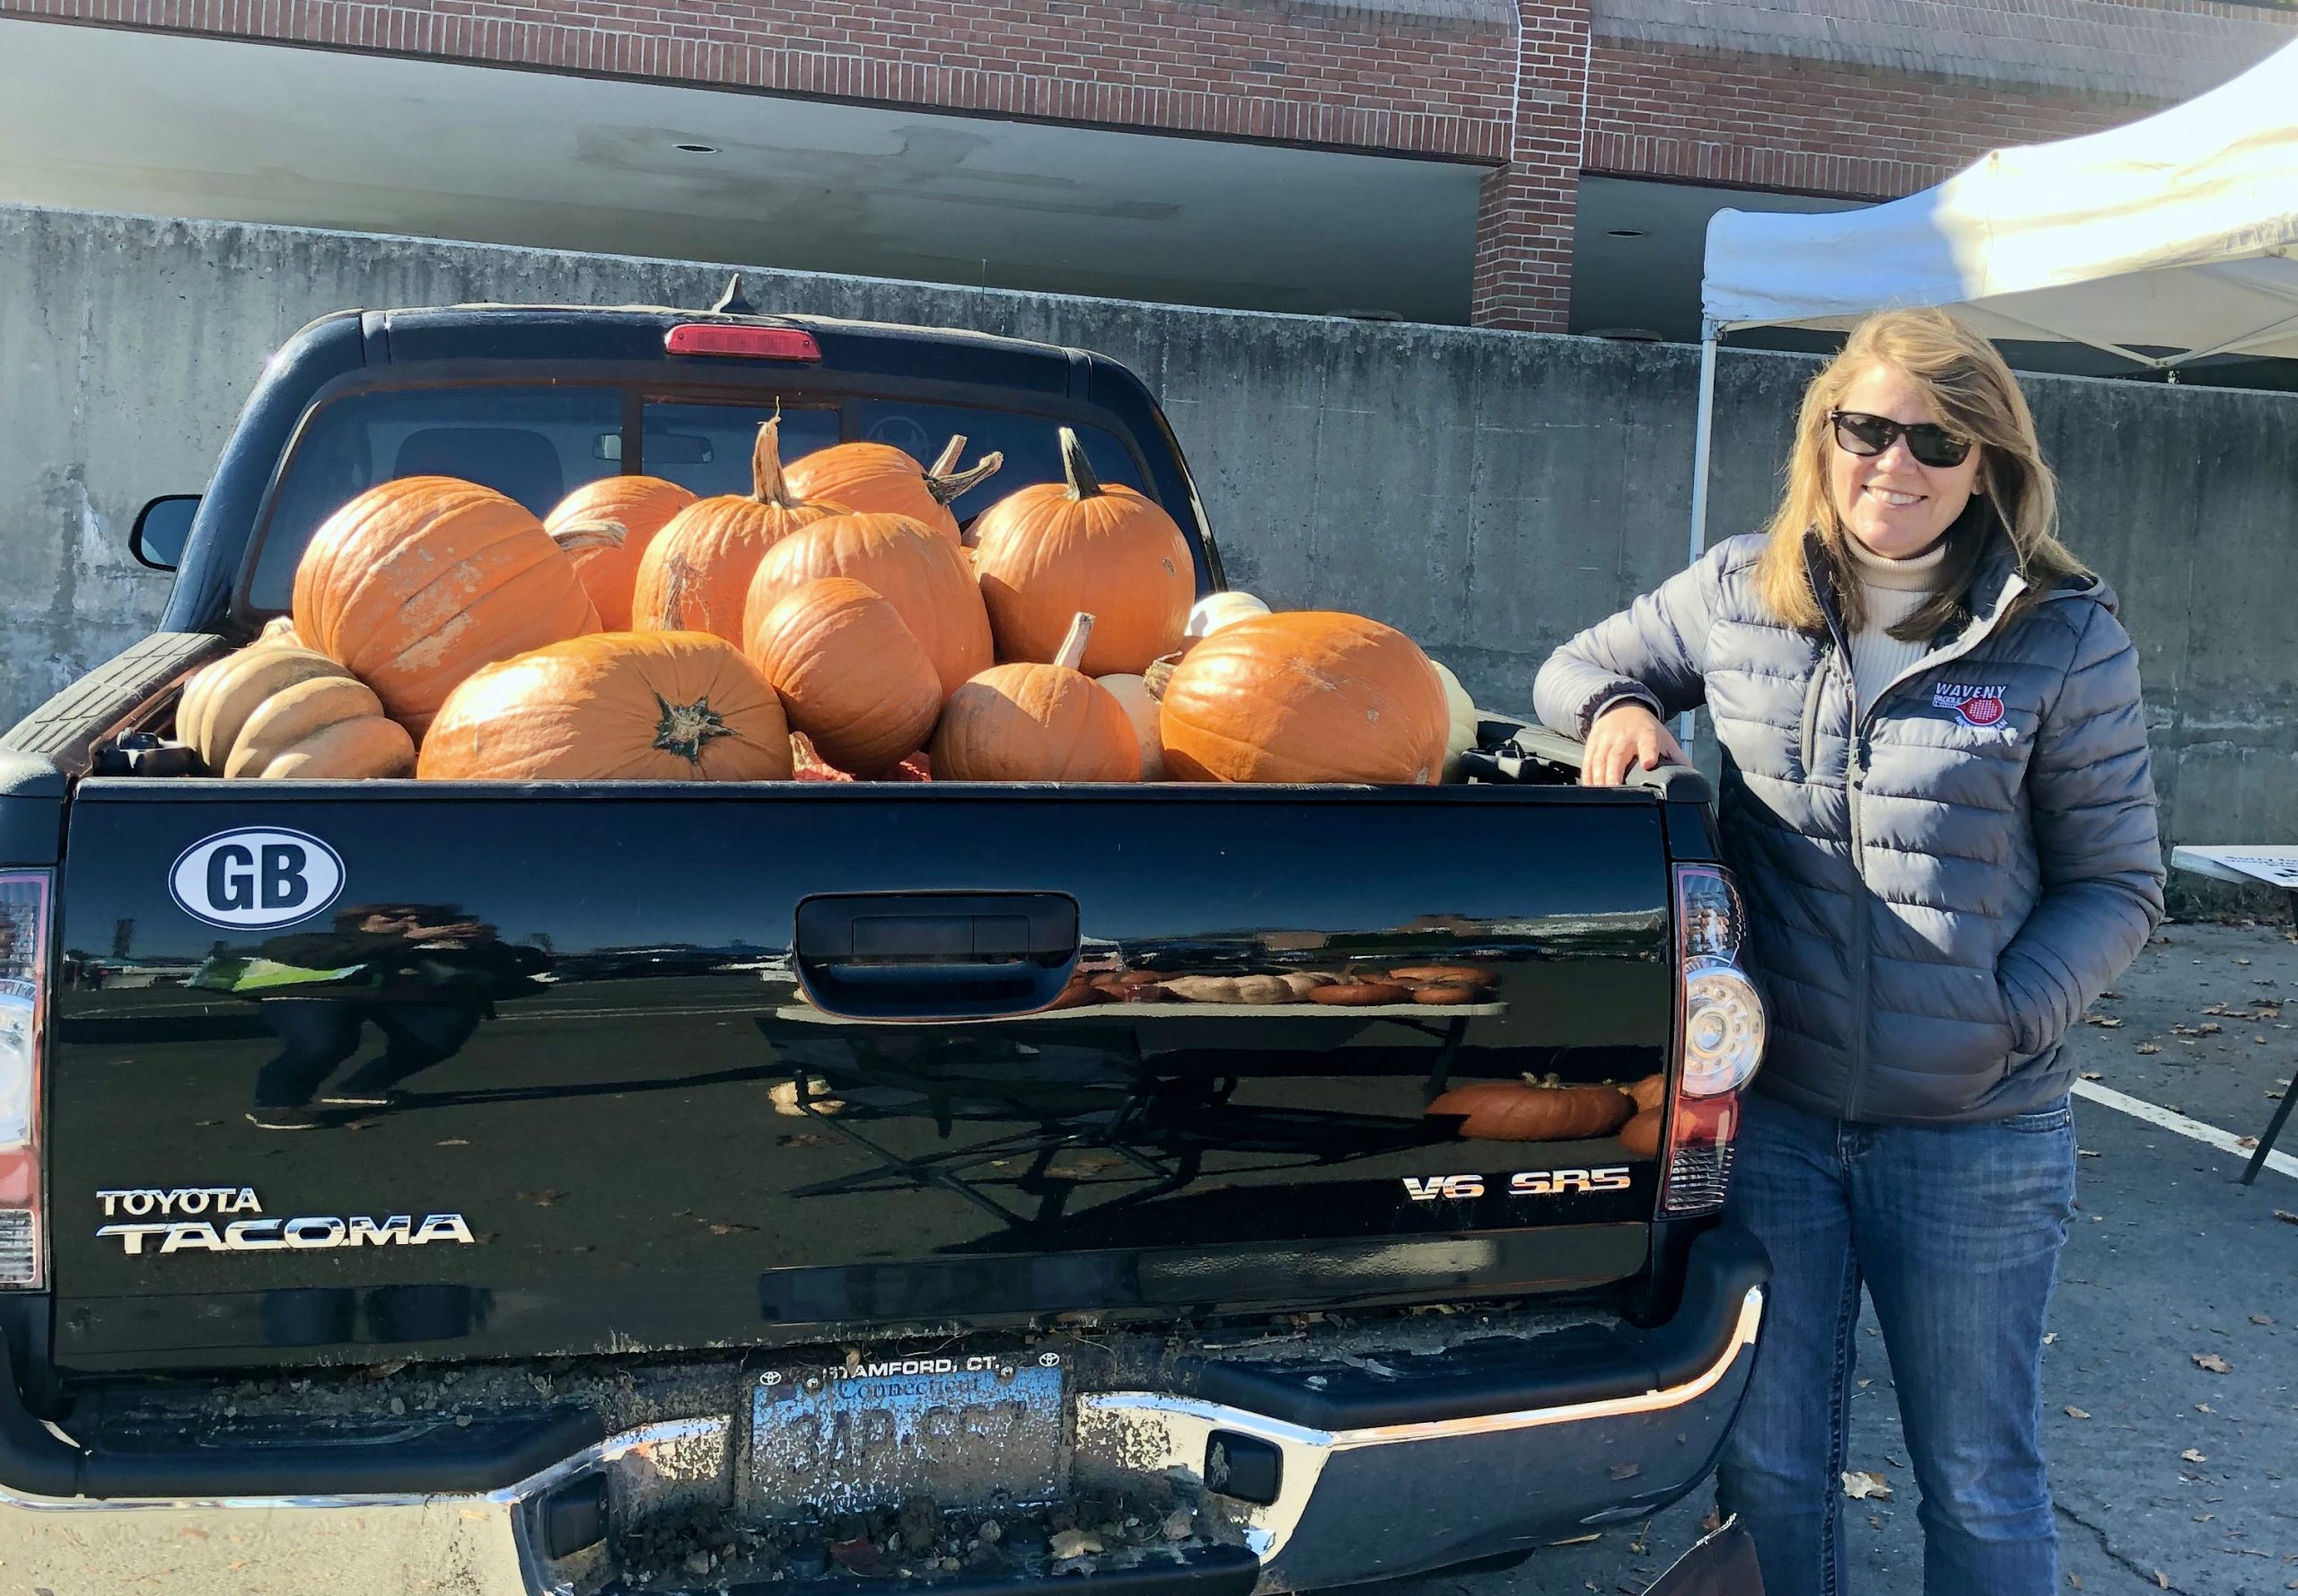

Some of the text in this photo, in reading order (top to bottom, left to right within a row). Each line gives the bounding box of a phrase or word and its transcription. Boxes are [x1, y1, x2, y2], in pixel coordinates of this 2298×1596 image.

[1934, 695, 1962, 705] PADDLE
[1935, 682, 2007, 698] WAVENY
[206, 844, 308, 911] GB
[1402, 1167, 1631, 1201] V6 SR5
[96, 1188, 262, 1216] TOYOTA
[96, 1214, 475, 1255] TACOMA
[967, 1356, 1000, 1371] CT.
